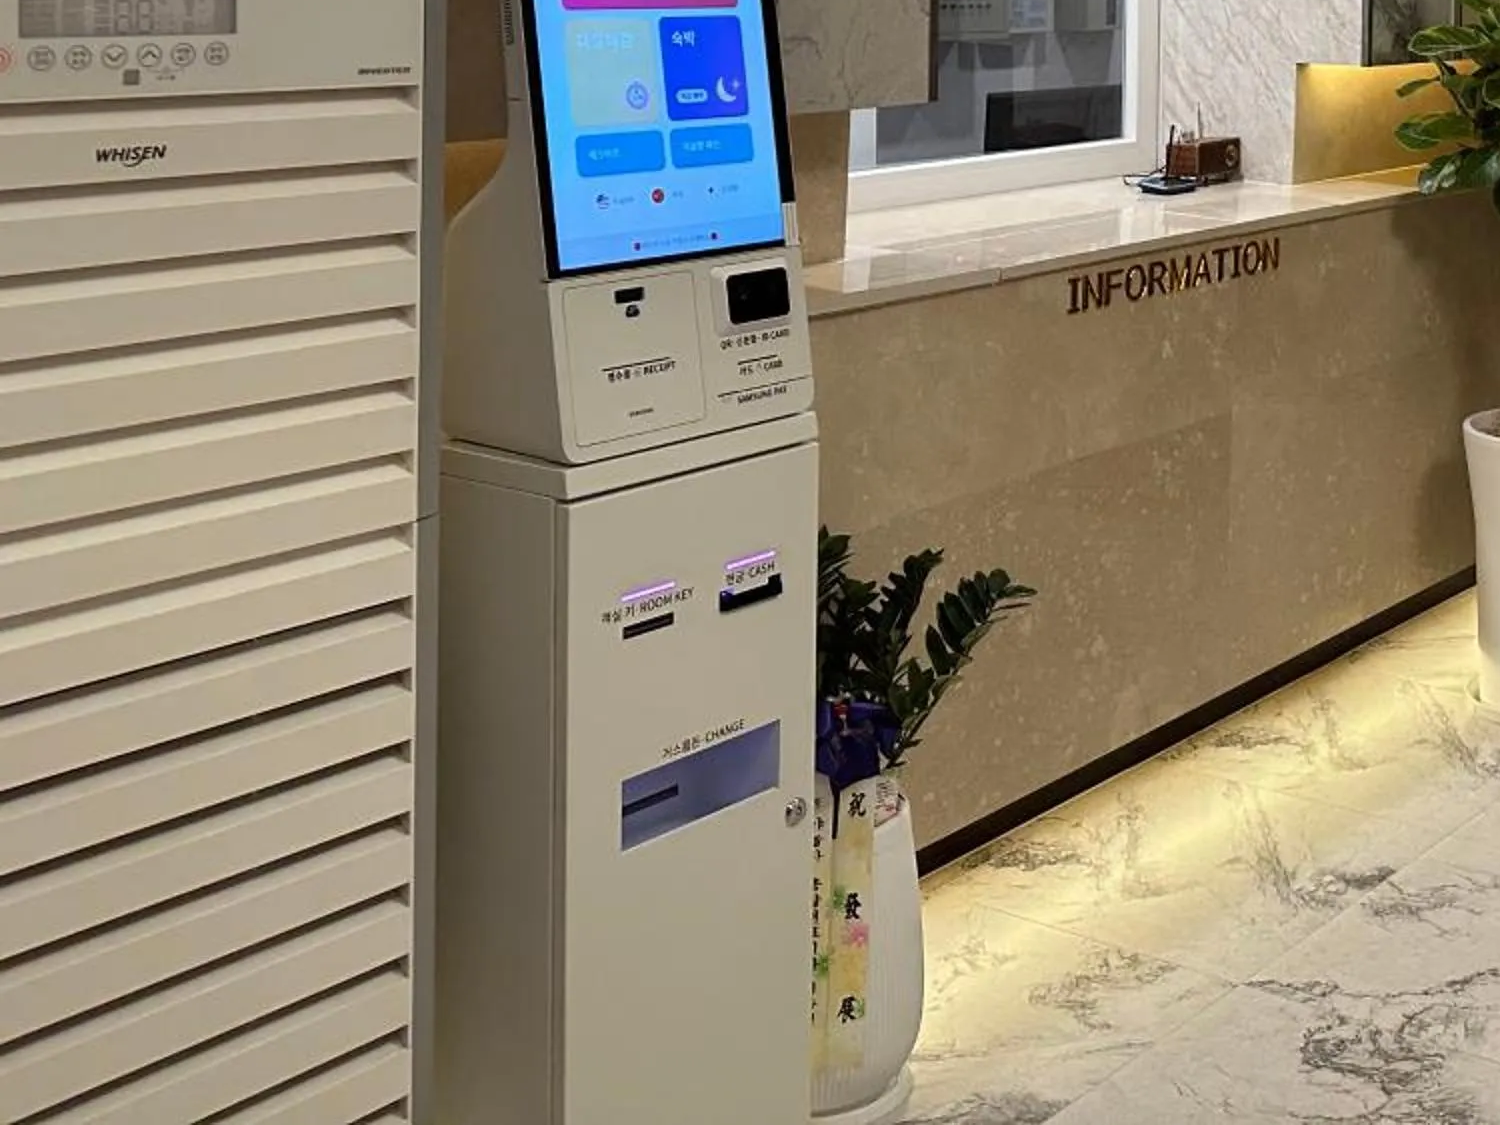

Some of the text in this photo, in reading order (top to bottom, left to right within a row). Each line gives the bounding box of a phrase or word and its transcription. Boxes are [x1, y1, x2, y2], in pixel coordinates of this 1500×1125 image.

[671, 30, 695, 47] 숙박
[96, 144, 167, 165] WHISEN
[1066, 237, 1281, 315] INFORMATION
[643, 360, 676, 376] RECEIPT
[748, 560, 775, 579] CASH
[675, 586, 695, 603] KEY
[705, 718, 745, 743] CHANGE
